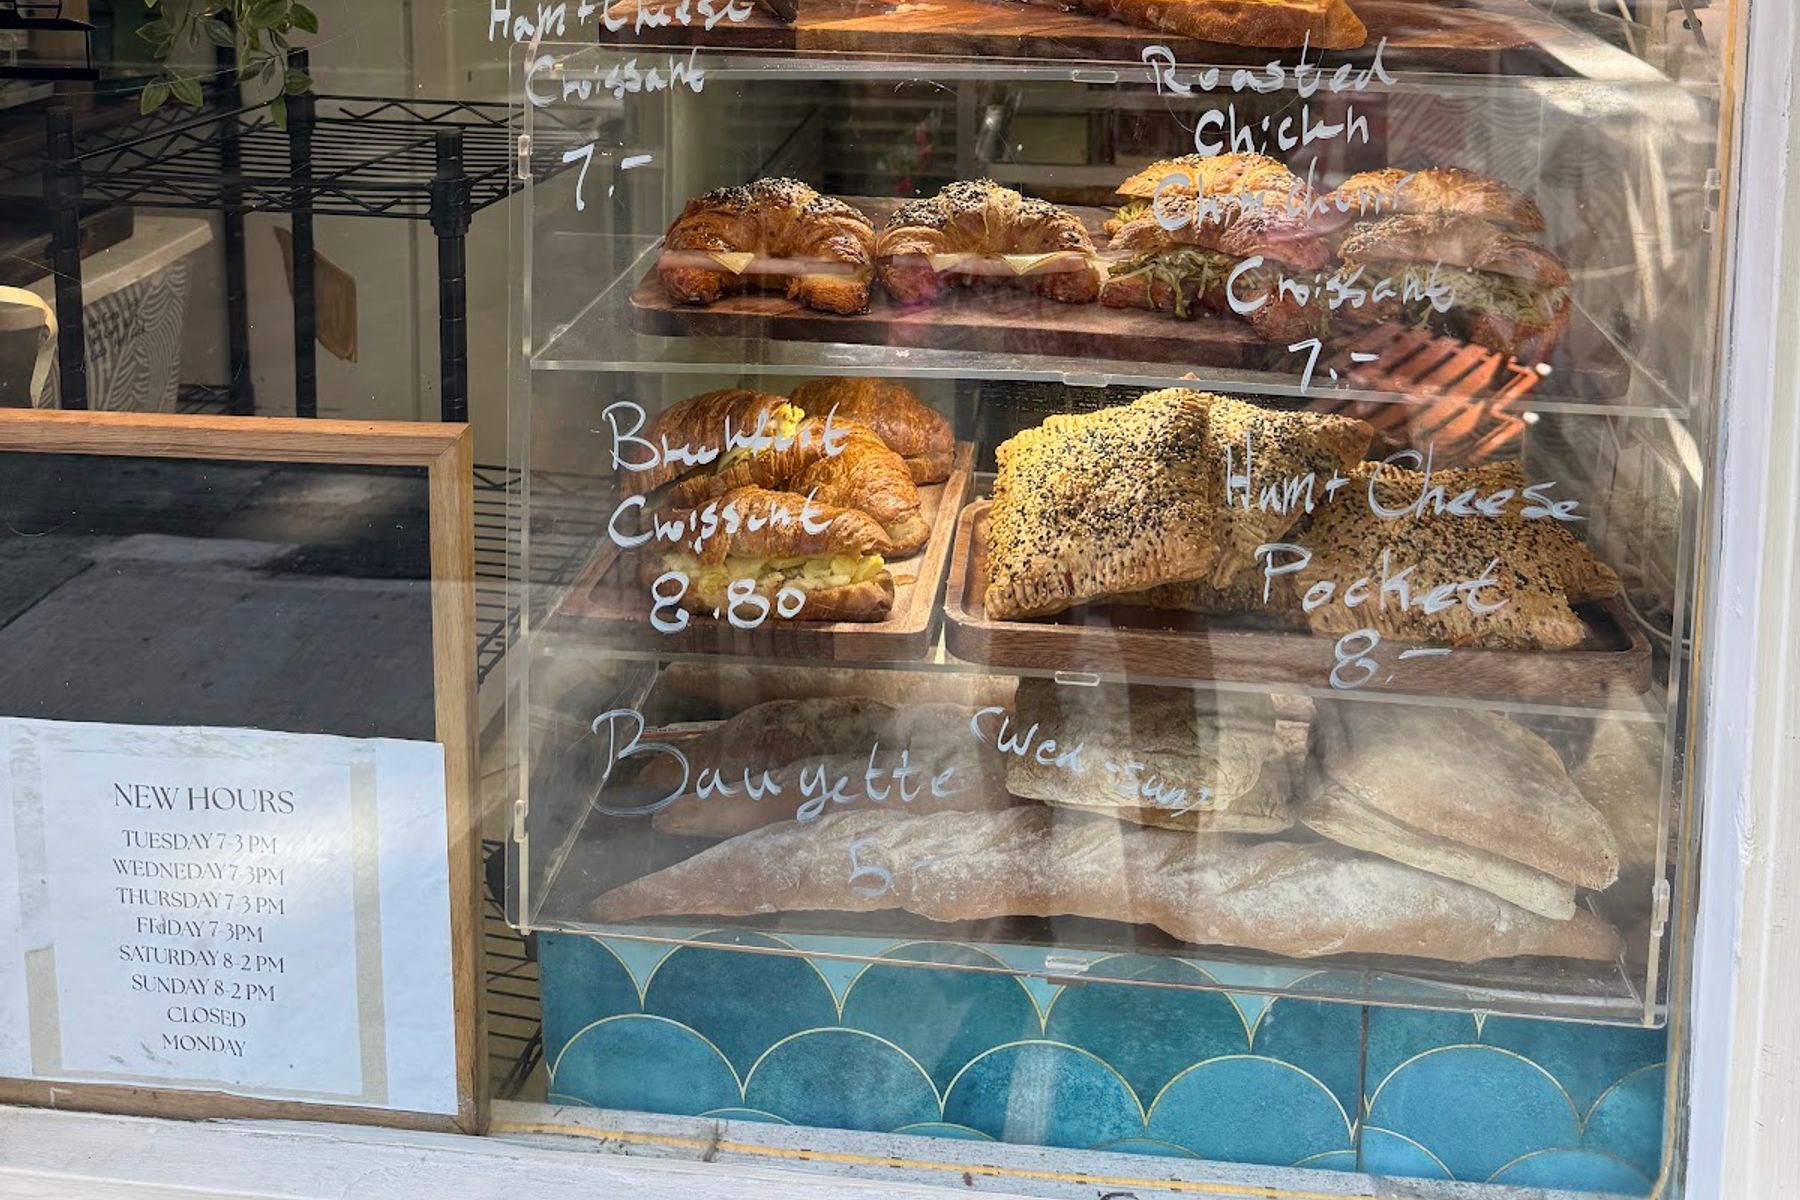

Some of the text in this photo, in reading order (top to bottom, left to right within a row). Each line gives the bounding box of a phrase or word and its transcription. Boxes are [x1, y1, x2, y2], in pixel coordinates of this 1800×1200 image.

[1142, 29, 1397, 99] Roasted
[1226, 259, 1456, 316] Croissant
[1367, 440, 1591, 521] Cheese
[1254, 543, 1511, 616] Pocket
[650, 571, 807, 635] 8.80
[113, 782, 295, 815] NEW HOURS
[121, 829, 213, 851] TUESDAY
[249, 834, 278, 855] PM
[112, 857, 227, 881] WEDNEDAY
[115, 886, 222, 909] THURSDAY
[256, 896, 285, 915] PM
[136, 915, 205, 938] FRIDAY
[118, 943, 219, 967] SATURDAY
[256, 954, 285, 973] PM
[131, 973, 210, 996] SUNDAY
[246, 983, 275, 1002] PM
[166, 1005, 247, 1029] CLOSED
[161, 1032, 247, 1057] MONDAY
